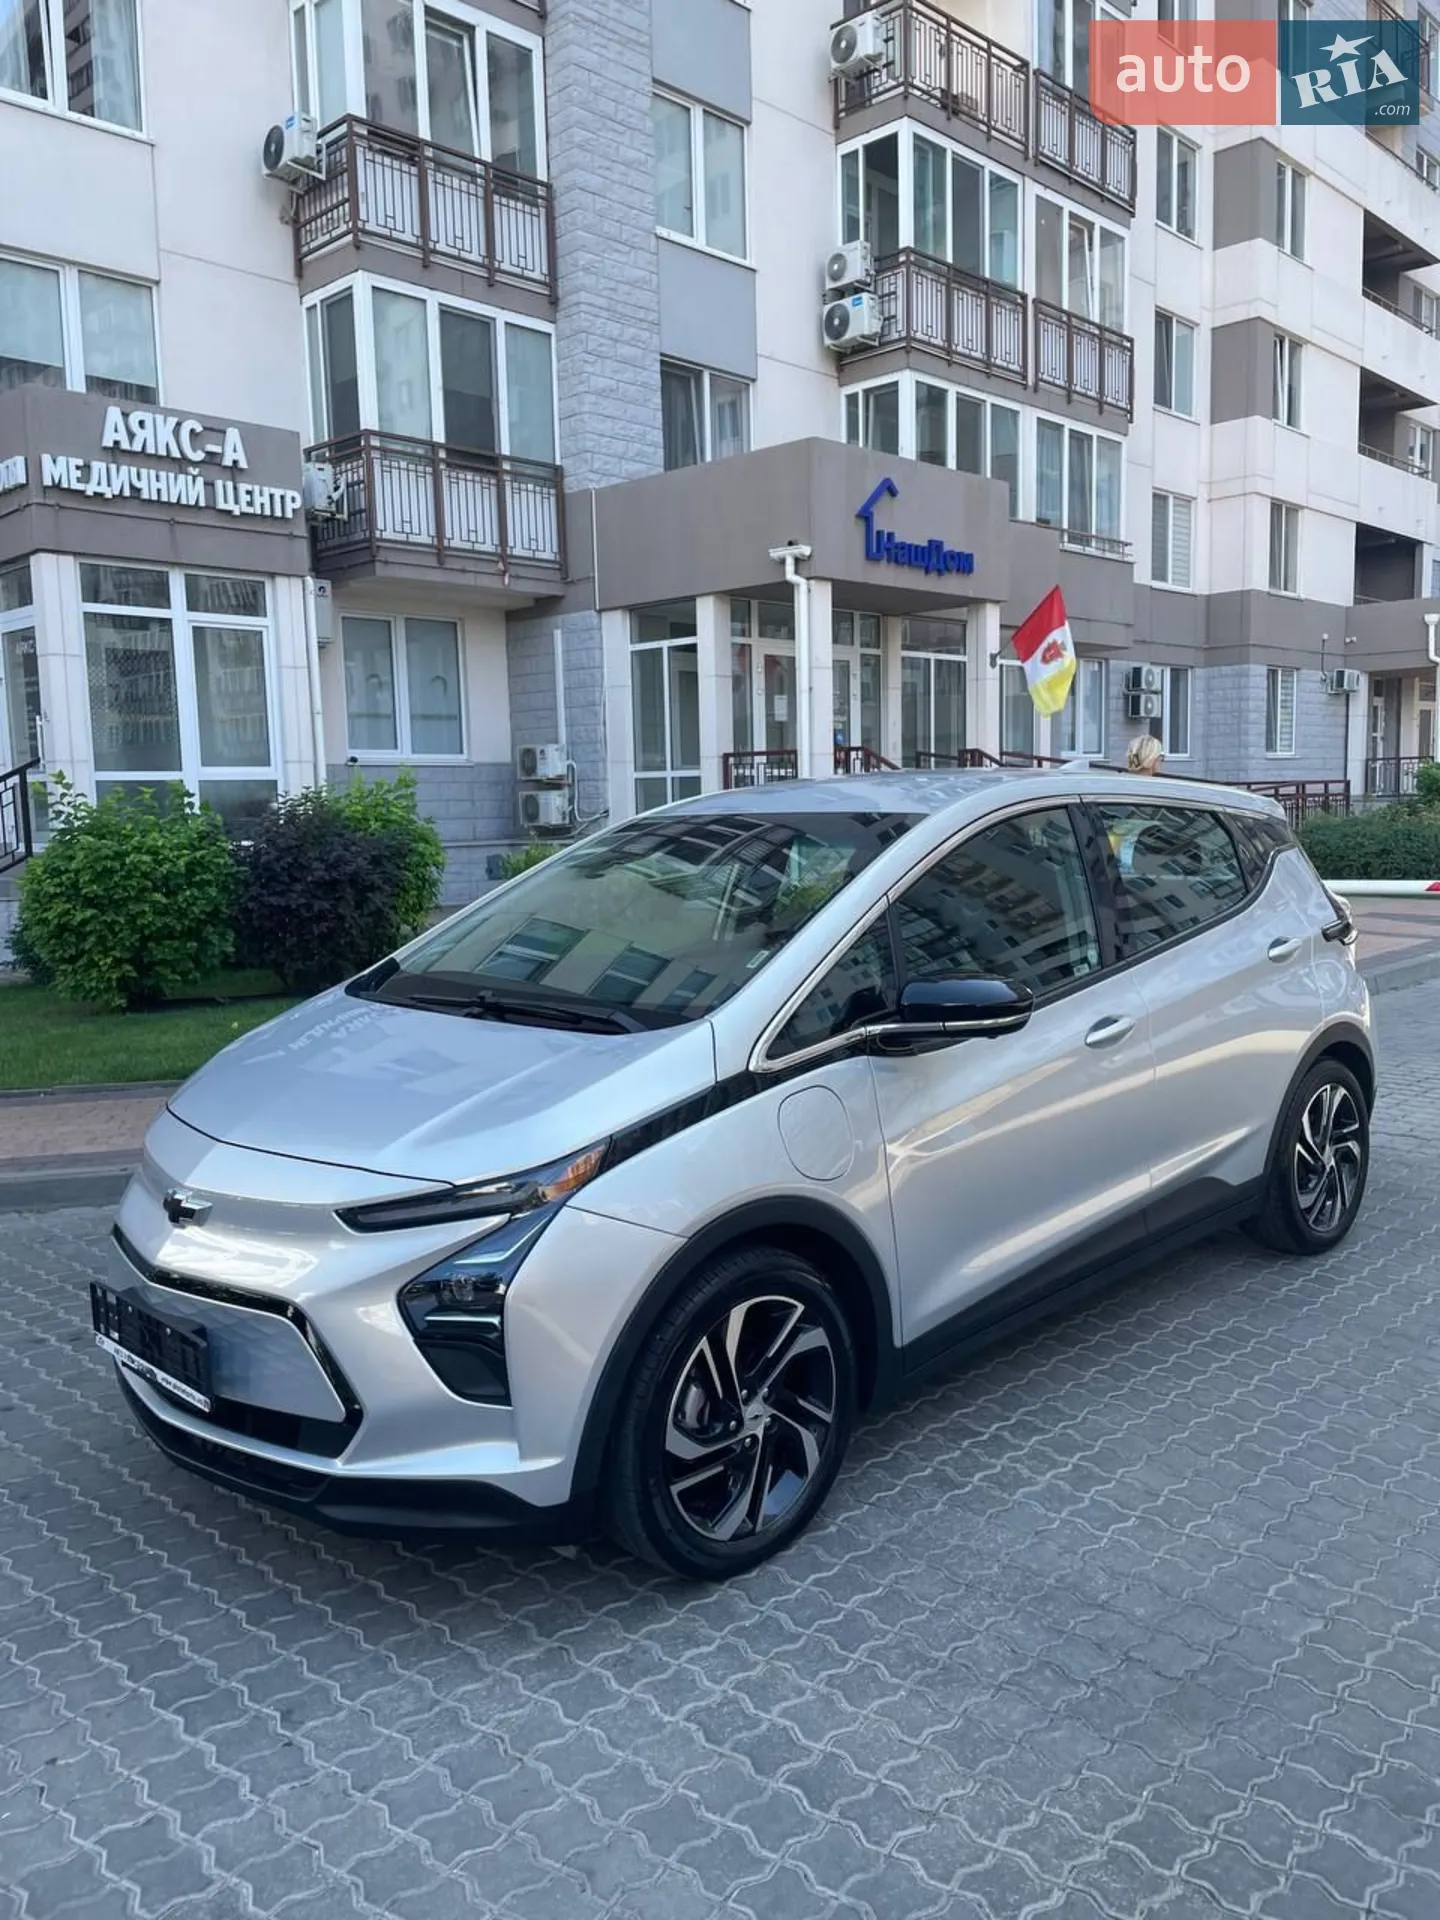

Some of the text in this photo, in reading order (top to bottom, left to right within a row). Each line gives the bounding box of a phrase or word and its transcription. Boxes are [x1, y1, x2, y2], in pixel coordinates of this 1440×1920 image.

[101, 405, 249, 470] АЯКС-А
[41, 453, 206, 508] МЕДИЧНИЙ
[213, 479, 302, 519] ЦЕНТР
